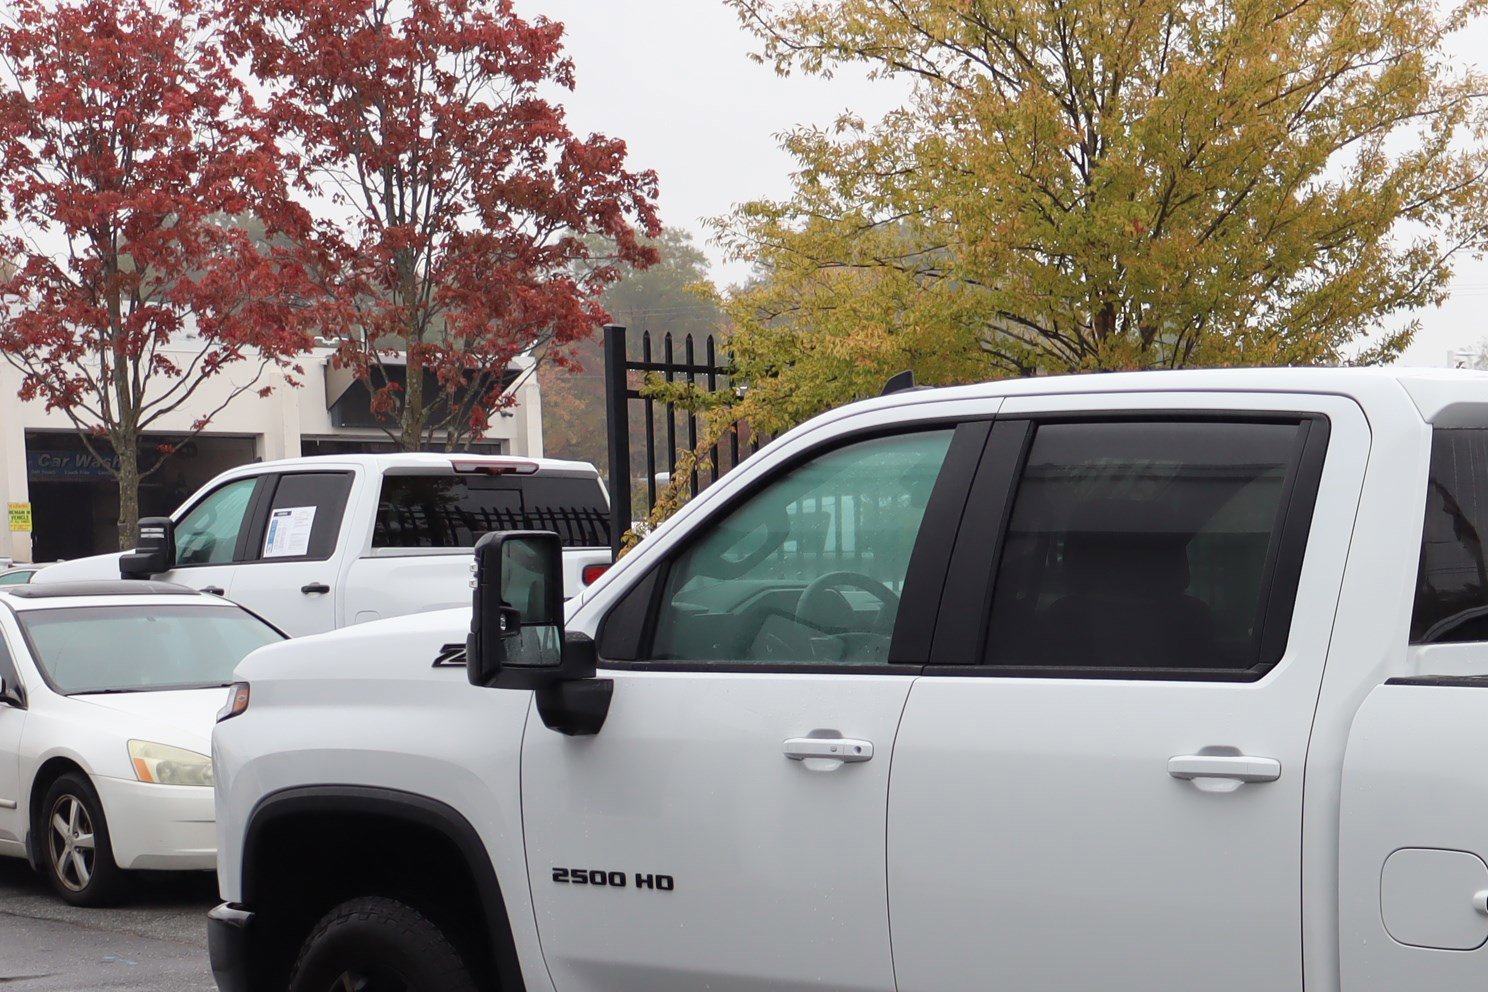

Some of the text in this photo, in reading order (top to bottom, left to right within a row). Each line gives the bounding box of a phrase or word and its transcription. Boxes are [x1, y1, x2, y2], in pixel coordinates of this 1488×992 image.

[38, 453, 70, 468] Car
[552, 867, 674, 891] 2500 HD
